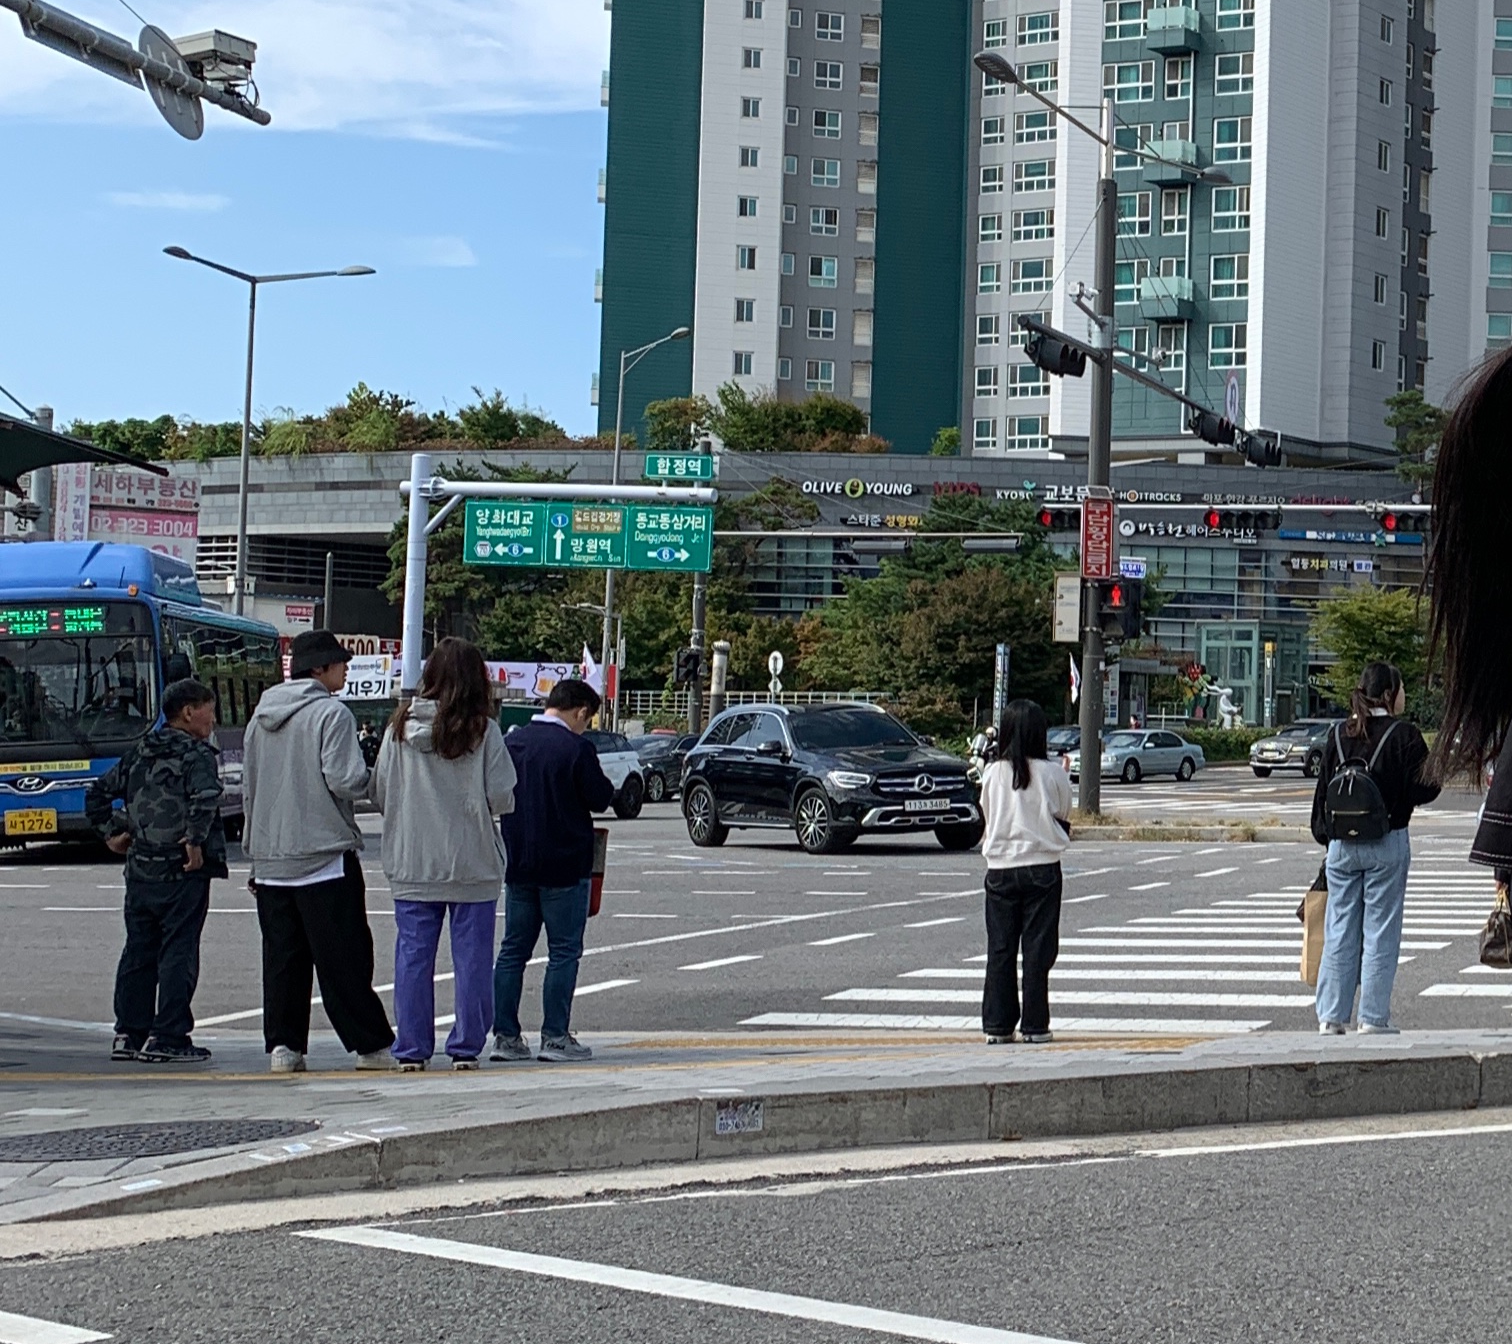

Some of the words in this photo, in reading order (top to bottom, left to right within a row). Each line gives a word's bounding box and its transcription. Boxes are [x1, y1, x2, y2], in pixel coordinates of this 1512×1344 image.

[656, 458, 701, 475] 합정역
[94, 473, 198, 499] 세하부동산
[802, 481, 843, 494] OLIVE
[865, 482, 913, 496] YOUNG
[1043, 485, 1115, 502] 교보문
[556, 515, 563, 526] 1
[635, 512, 706, 531] 동교동삼거리
[884, 515, 923, 528] 성형외
[570, 538, 612, 554] 망원역
[1087, 502, 1109, 576] 무단횡단금지
[512, 544, 519, 555] 6
[661, 549, 671, 561] 6
[345, 679, 387, 697] 지우기
[20, 818, 54, 832] 1276
